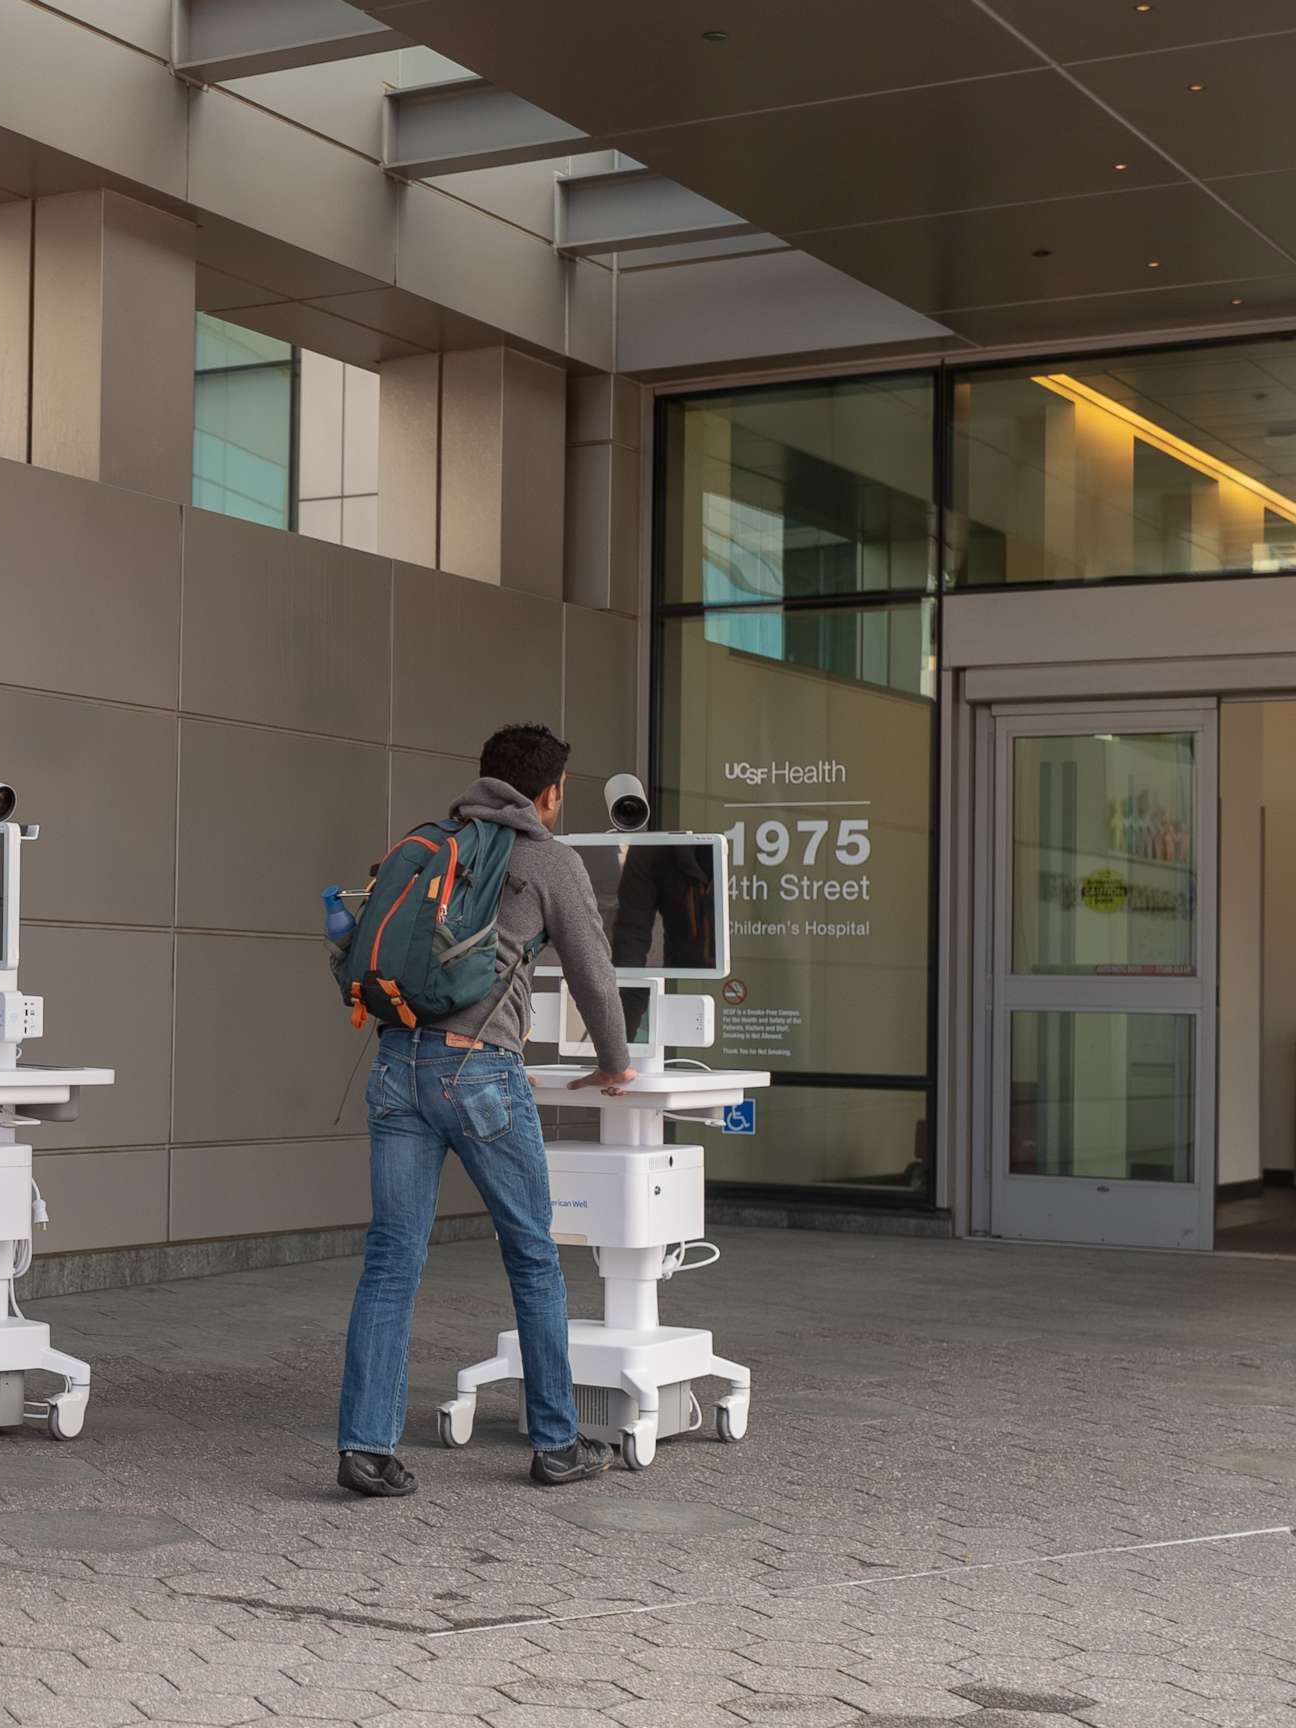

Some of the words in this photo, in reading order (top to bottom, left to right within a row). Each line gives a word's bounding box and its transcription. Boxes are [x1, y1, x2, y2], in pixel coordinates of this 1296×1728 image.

[724, 763, 768, 785] UCSF
[772, 760, 846, 784] Health
[724, 819, 871, 866] 1975
[780, 873, 871, 901] Street
[805, 920, 870, 939] Hospital
